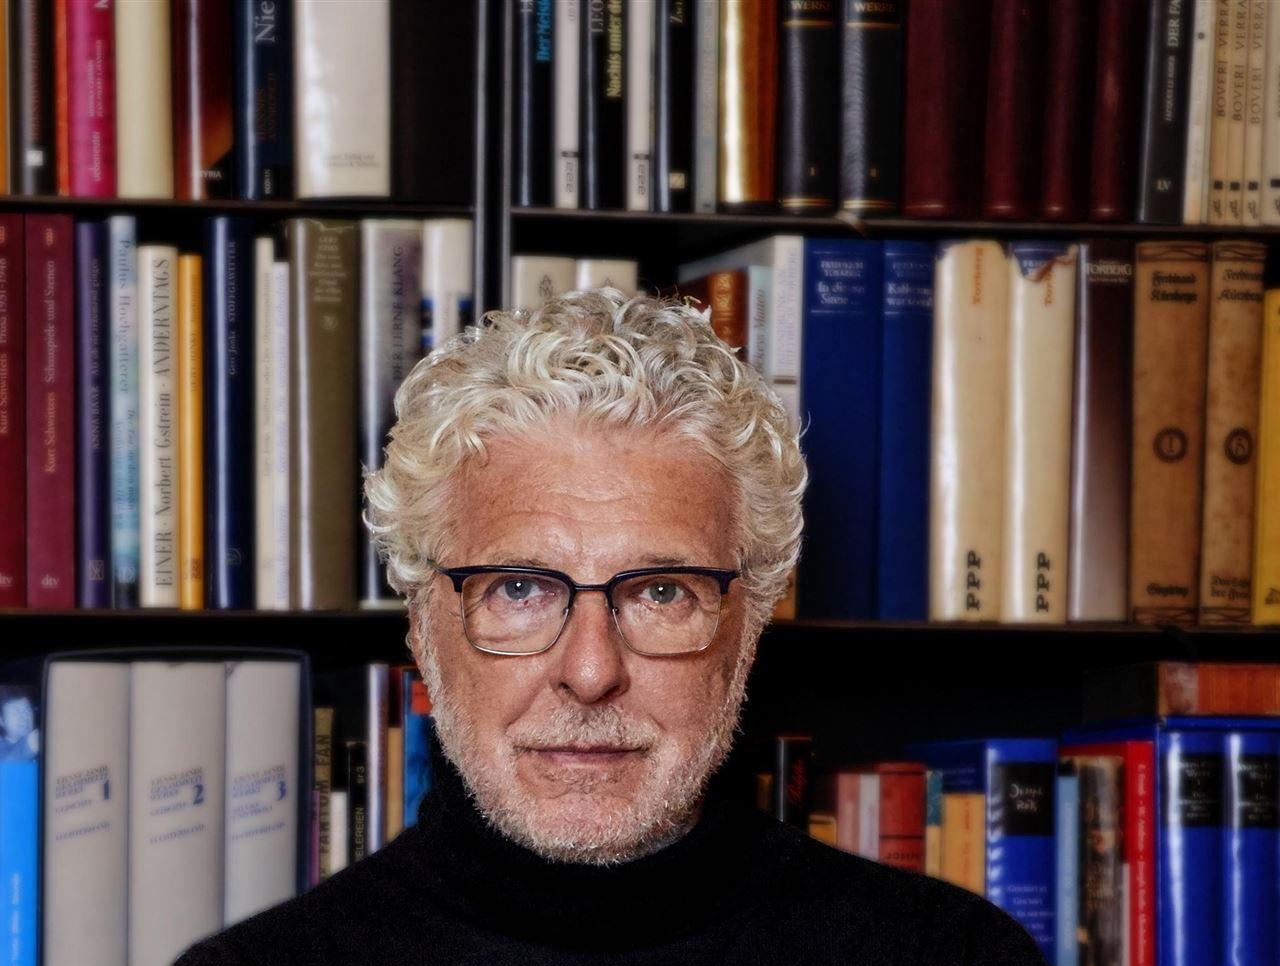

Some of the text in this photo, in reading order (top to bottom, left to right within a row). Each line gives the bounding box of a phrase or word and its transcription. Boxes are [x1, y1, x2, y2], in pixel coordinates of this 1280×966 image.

[43, 391, 57, 447] Schwitters
[152, 257, 174, 587] EINER Norbert Gstrein ANDERNTAGS
[44, 447, 57, 475] Kurt
